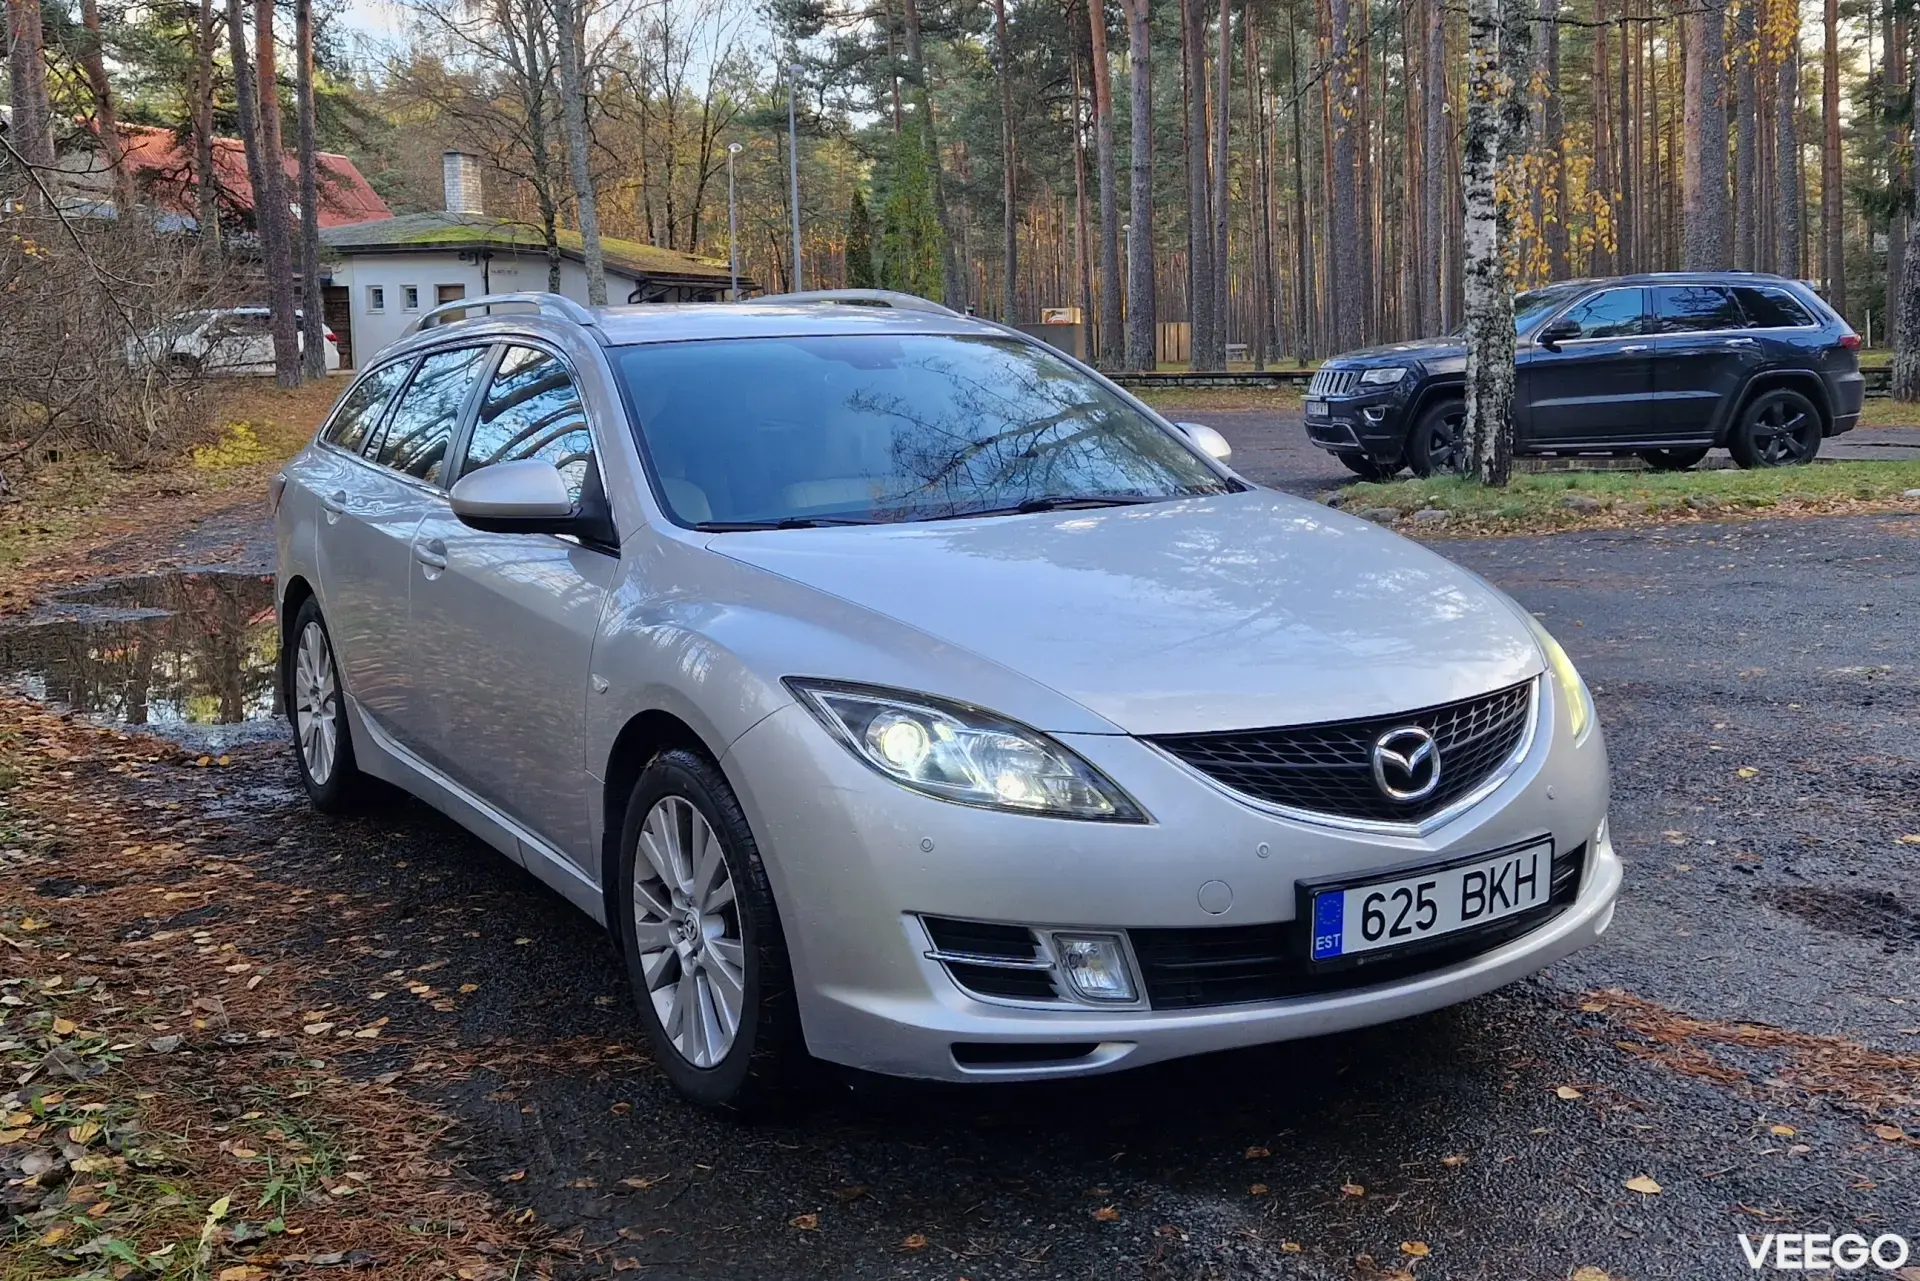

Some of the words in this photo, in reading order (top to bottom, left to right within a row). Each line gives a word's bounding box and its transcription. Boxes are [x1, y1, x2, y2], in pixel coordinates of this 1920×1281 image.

[1362, 881, 1438, 942] 625
[1461, 853, 1538, 922] BKH
[1316, 933, 1342, 950] EST
